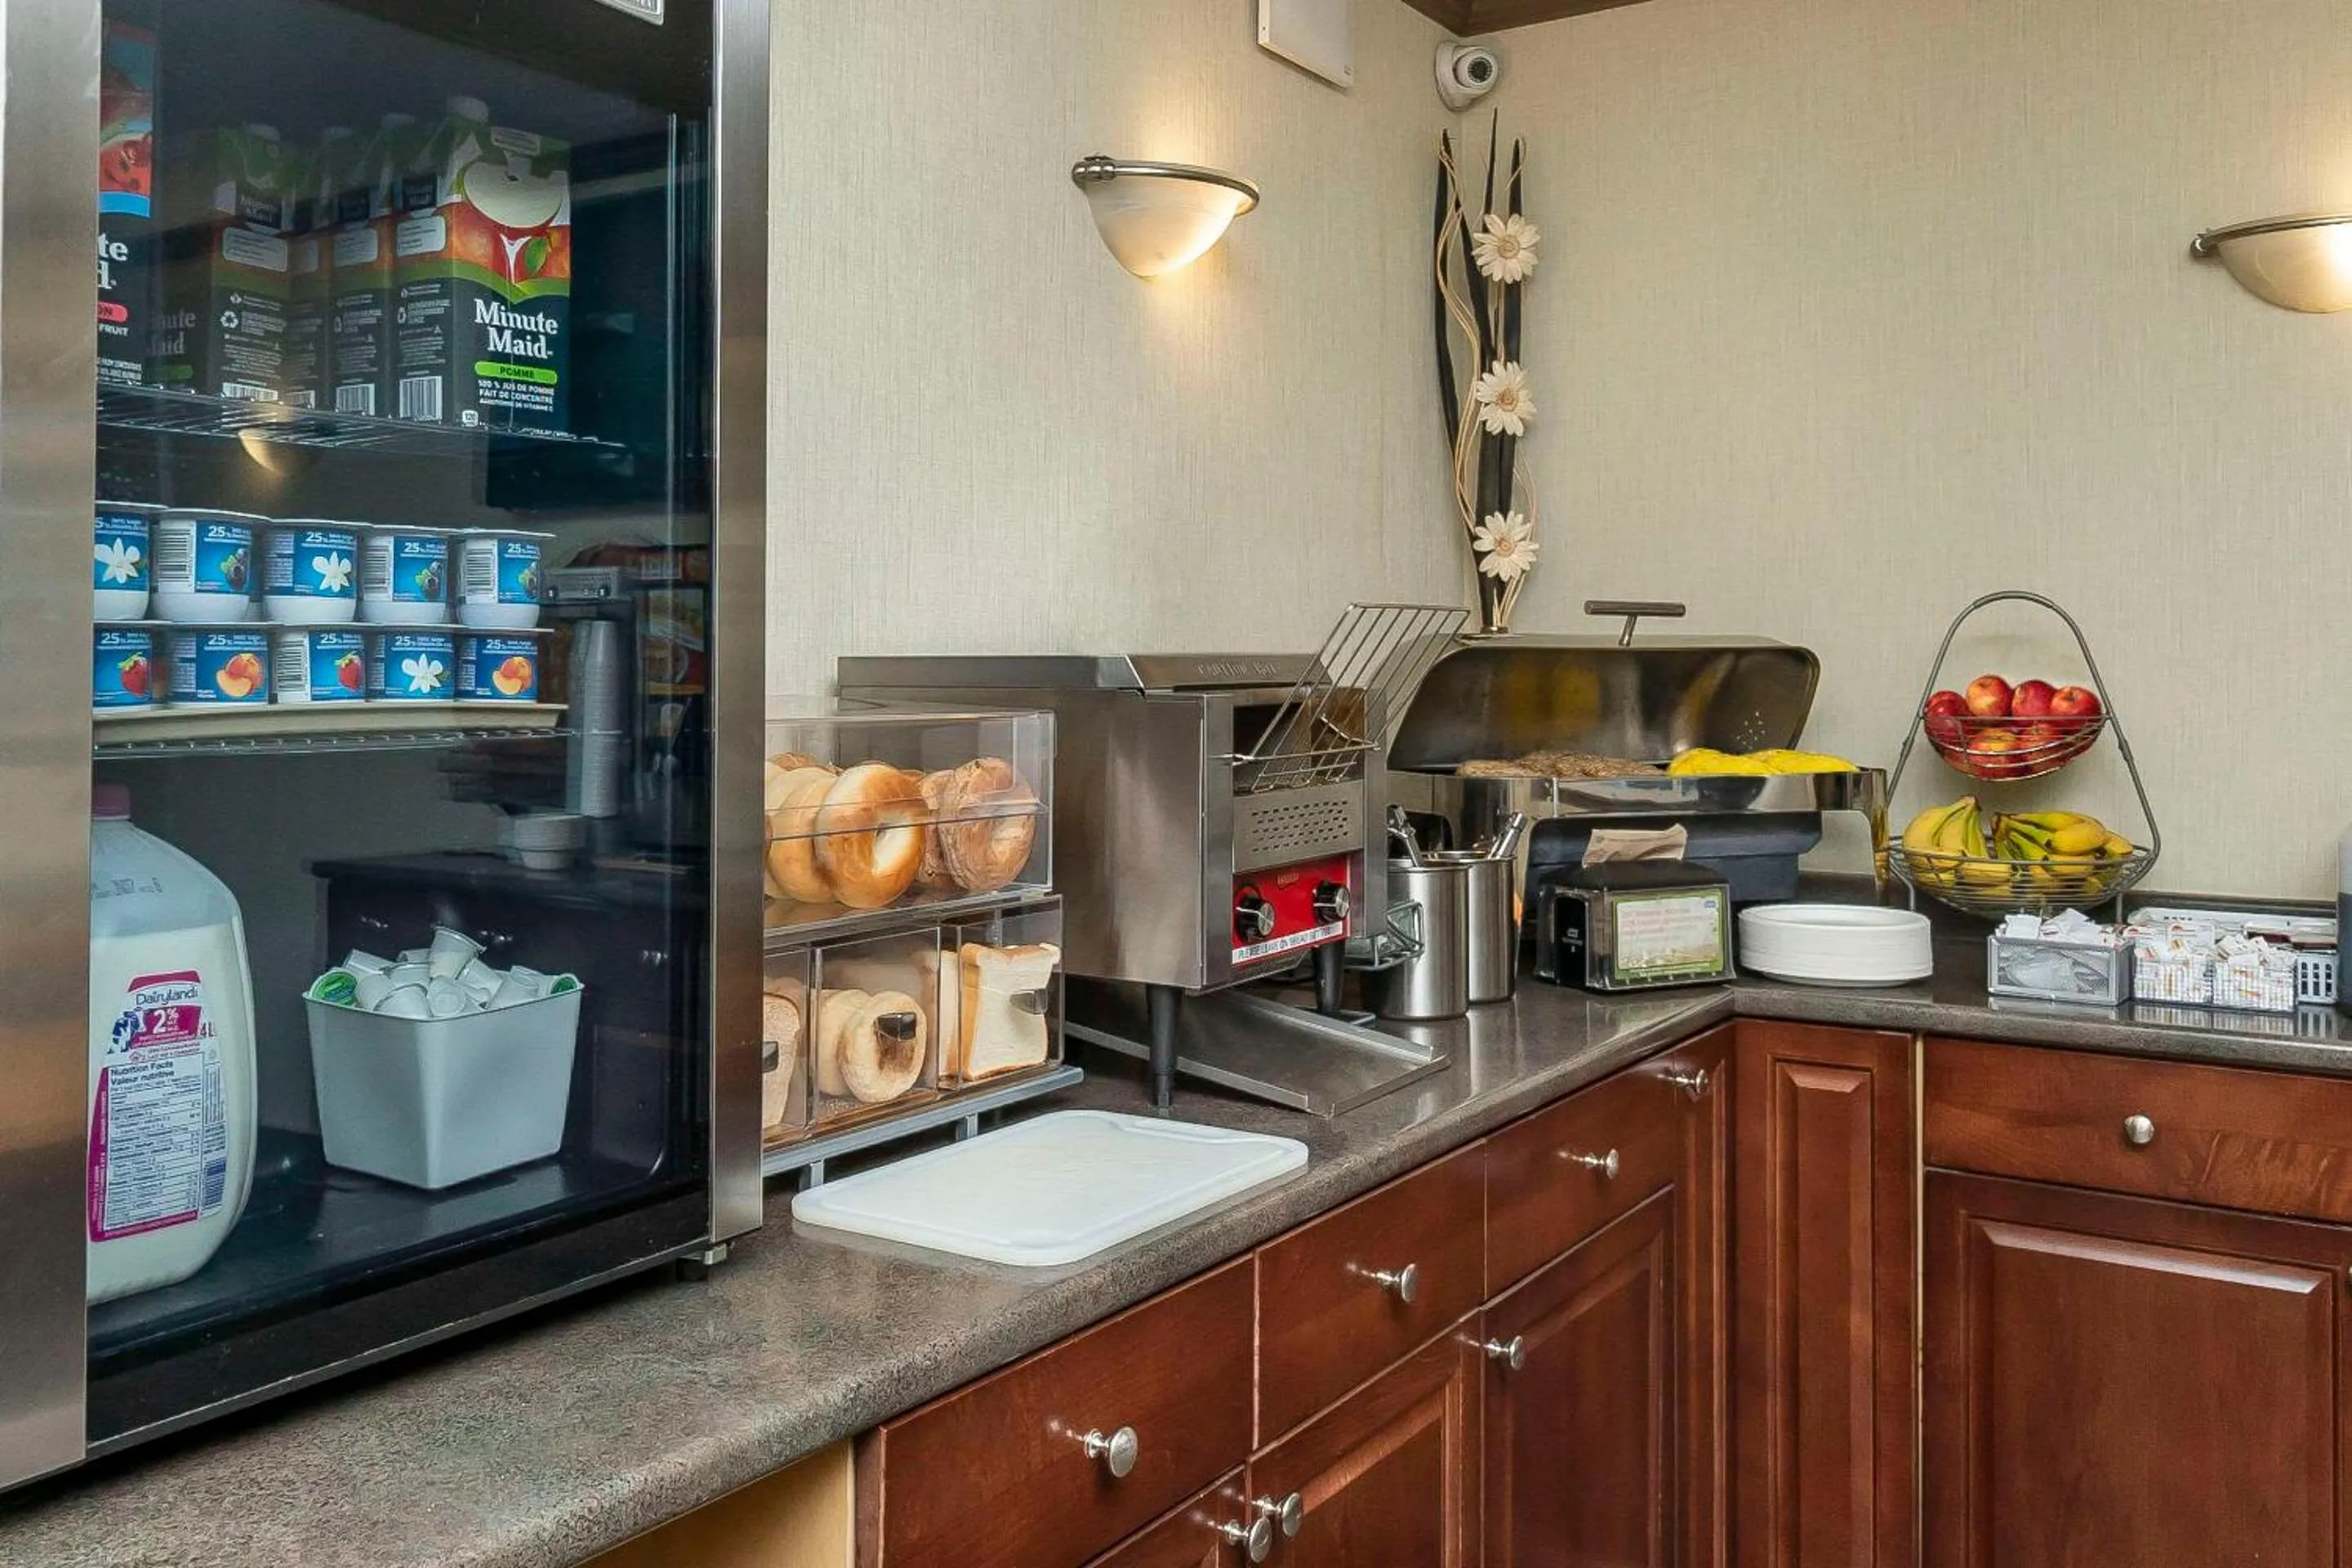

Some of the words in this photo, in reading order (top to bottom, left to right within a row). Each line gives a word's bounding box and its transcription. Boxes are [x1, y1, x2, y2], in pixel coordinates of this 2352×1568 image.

[474, 298, 559, 335] Minute
[487, 327, 549, 359] Maid
[479, 388, 497, 398] FAIT
[136, 986, 196, 1005] Dairyland
[110, 1065, 149, 1076] Nutrition
[150, 1061, 174, 1071] Facts
[110, 1076, 139, 1086] Valeur
